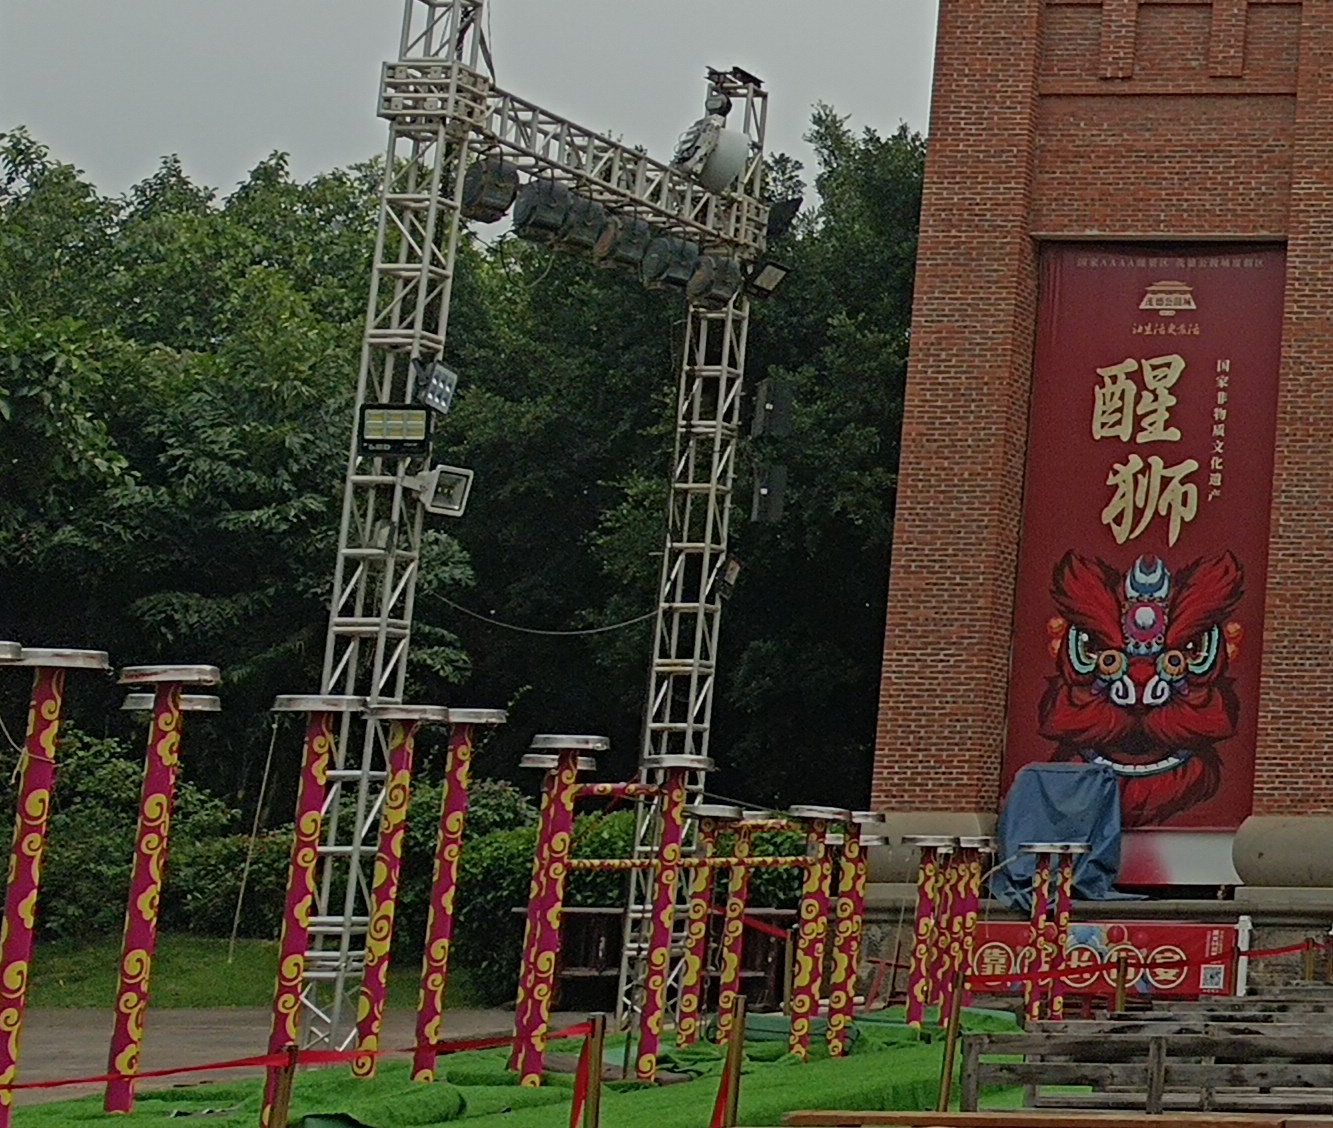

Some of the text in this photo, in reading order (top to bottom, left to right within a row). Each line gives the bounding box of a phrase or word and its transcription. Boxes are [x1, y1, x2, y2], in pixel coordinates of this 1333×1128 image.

[1091, 353, 1200, 548] 醒狮
[1206, 358, 1231, 502] 国家非物质文化遗产
